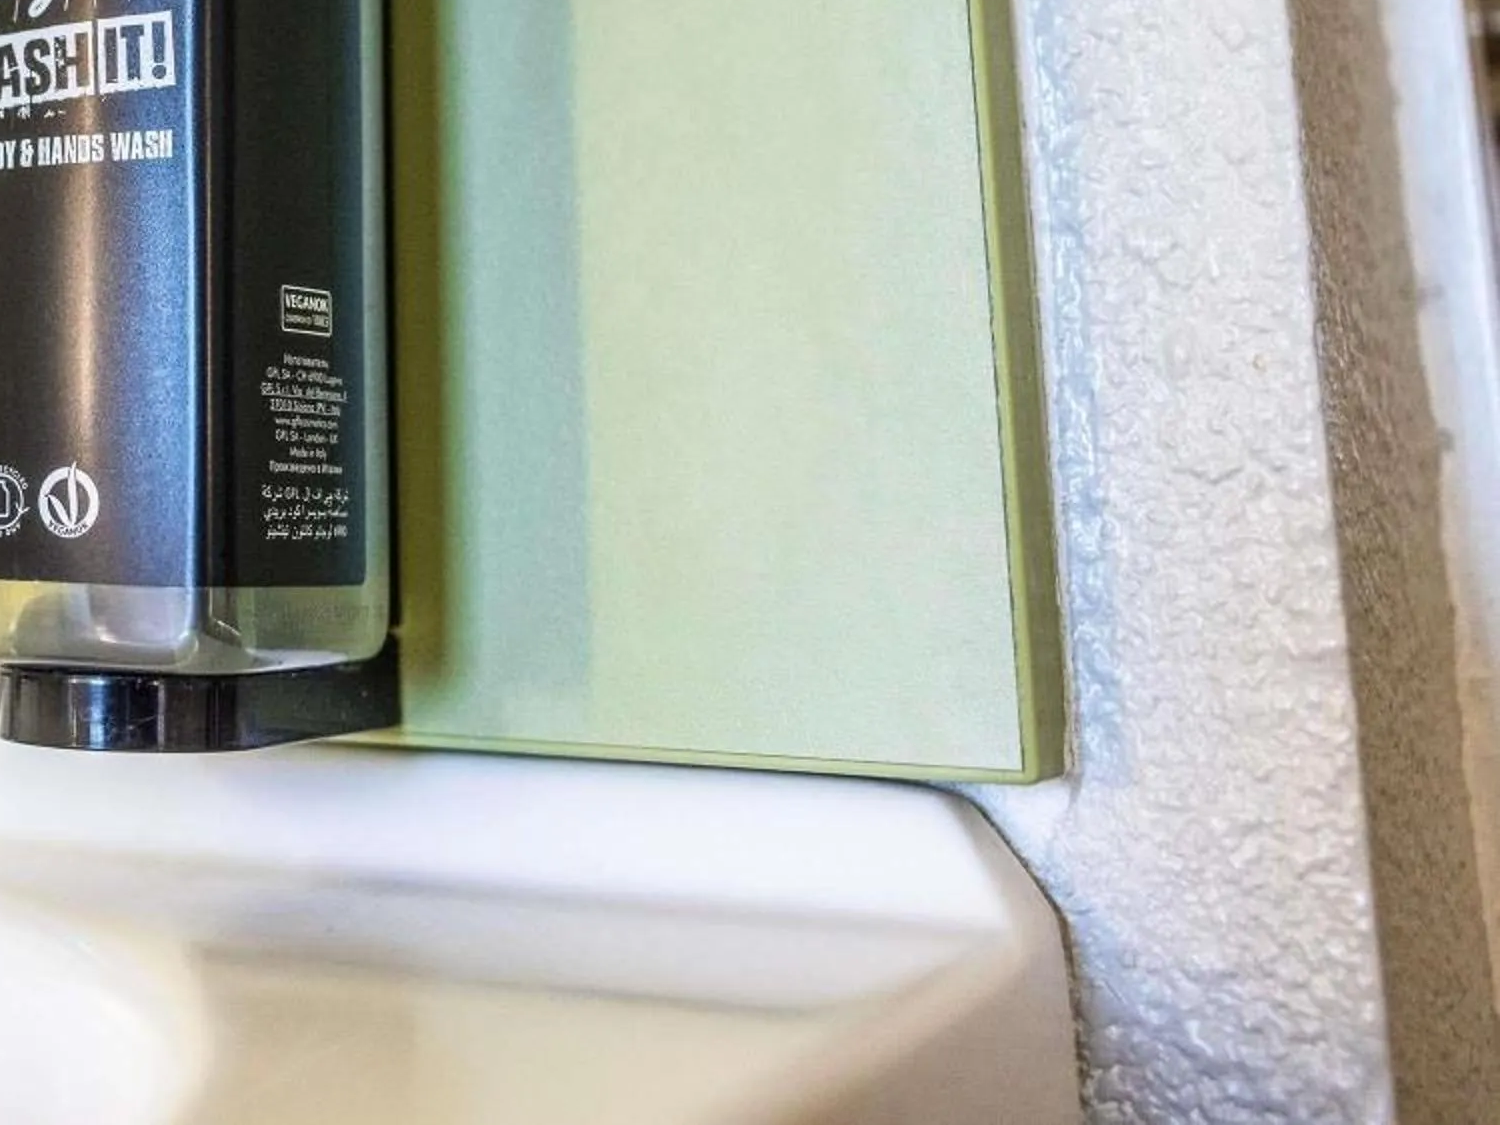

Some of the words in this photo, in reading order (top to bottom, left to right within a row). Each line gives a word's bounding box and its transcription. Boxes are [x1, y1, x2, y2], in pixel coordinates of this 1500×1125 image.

[103, 21, 167, 85] IT!
[19, 142, 34, 166] &
[37, 135, 104, 167] HANDS
[110, 129, 174, 162] WASH
